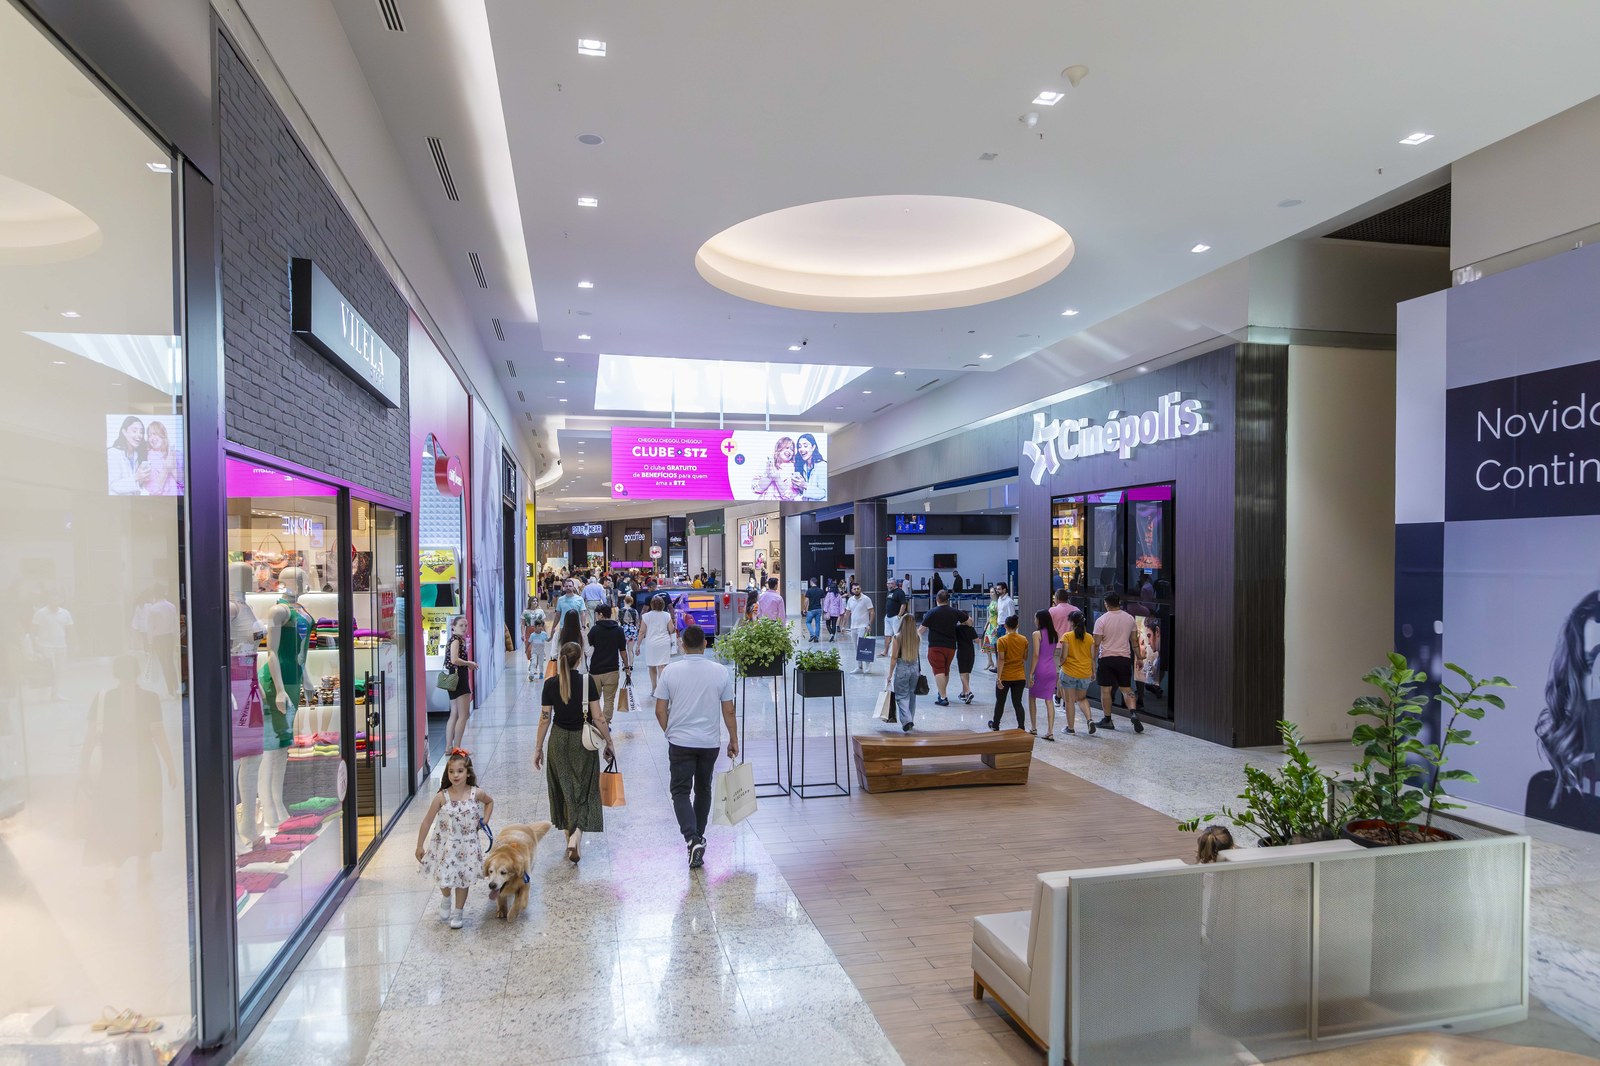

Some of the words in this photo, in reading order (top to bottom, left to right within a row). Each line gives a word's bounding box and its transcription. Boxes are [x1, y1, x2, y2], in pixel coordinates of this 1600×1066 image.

[340, 301, 384, 376] VILELA
[632, 446, 675, 458] CLUBE
[683, 448, 708, 458] STZ
[624, 531, 645, 543] gocoffee
